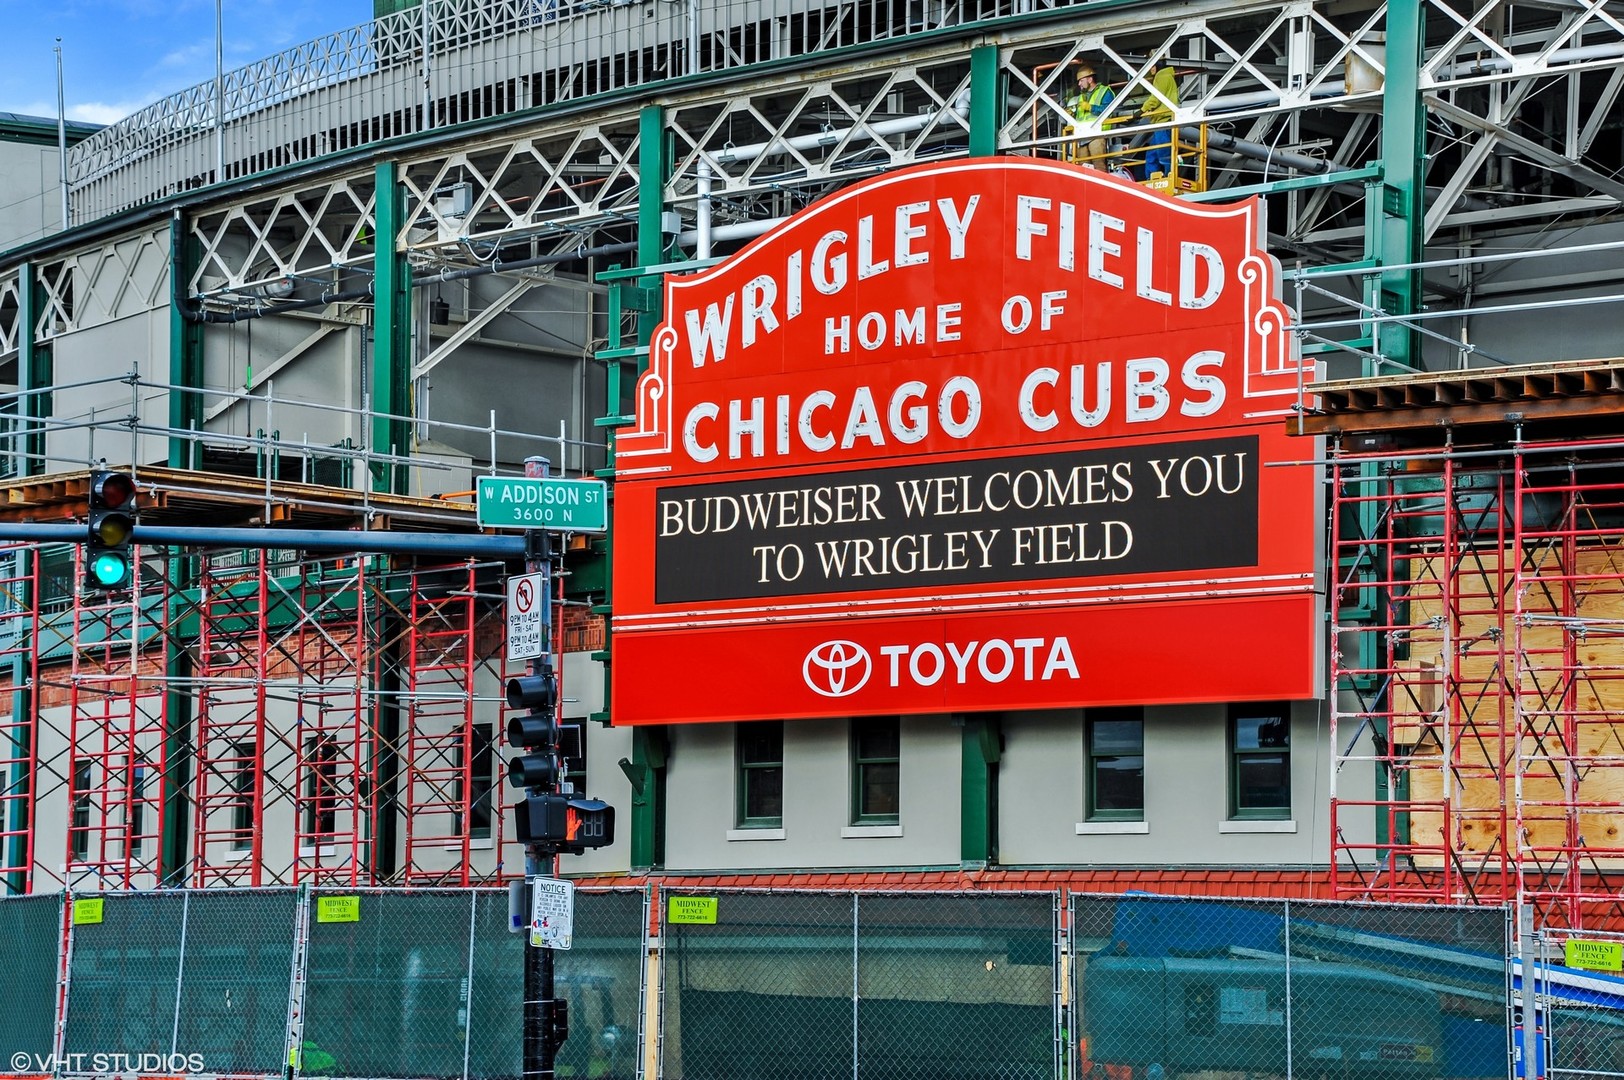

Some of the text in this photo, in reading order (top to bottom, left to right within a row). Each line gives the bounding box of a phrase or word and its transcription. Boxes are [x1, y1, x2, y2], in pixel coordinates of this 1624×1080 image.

[685, 194, 1226, 369] WRIGLEY FIELD
[824, 289, 1068, 355] HOME OF
[683, 350, 1227, 463] CHICAGO CUBS
[484, 484, 600, 506] W ADDISON ST
[660, 452, 1247, 537] BUDWEISER WELCOMES YOU
[513, 507, 572, 522] 3600 N
[753, 520, 1134, 584] TO WRIGLEY FIELD
[881, 637, 1080, 687] TOYOTA
[540, 883, 566, 894] NOTICE
[676, 900, 711, 908] MIDWEST
[1574, 943, 1615, 954] MIDWEST
[1581, 952, 1607, 960] FENCE
